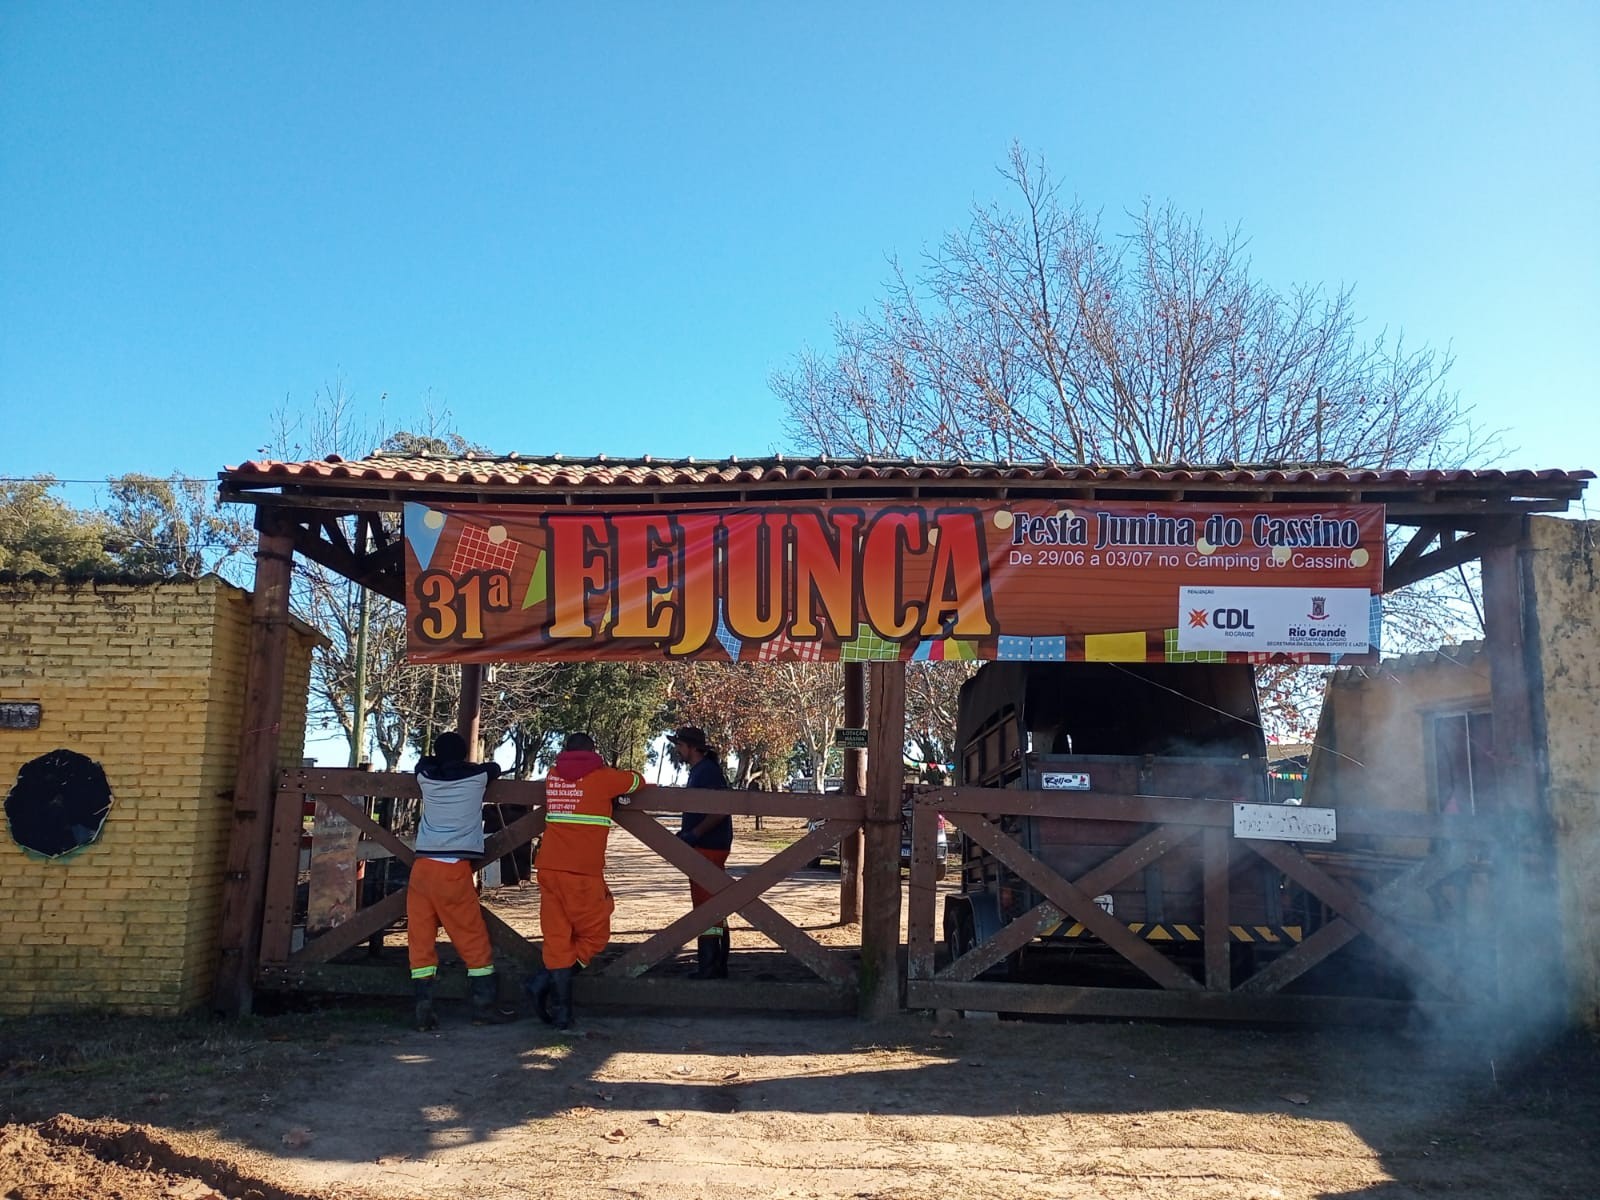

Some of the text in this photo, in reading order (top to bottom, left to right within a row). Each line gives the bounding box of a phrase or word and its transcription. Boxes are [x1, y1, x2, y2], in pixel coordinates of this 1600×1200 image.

[1012, 512, 1359, 549] Festa Junina do Cassino
[1009, 551, 1358, 571] De 29/06 a 03/07 no Camping do Cassino
[546, 508, 995, 656] FEJUNCA
[1213, 608, 1255, 630] CDL
[1288, 627, 1346, 637] Rio Grande
